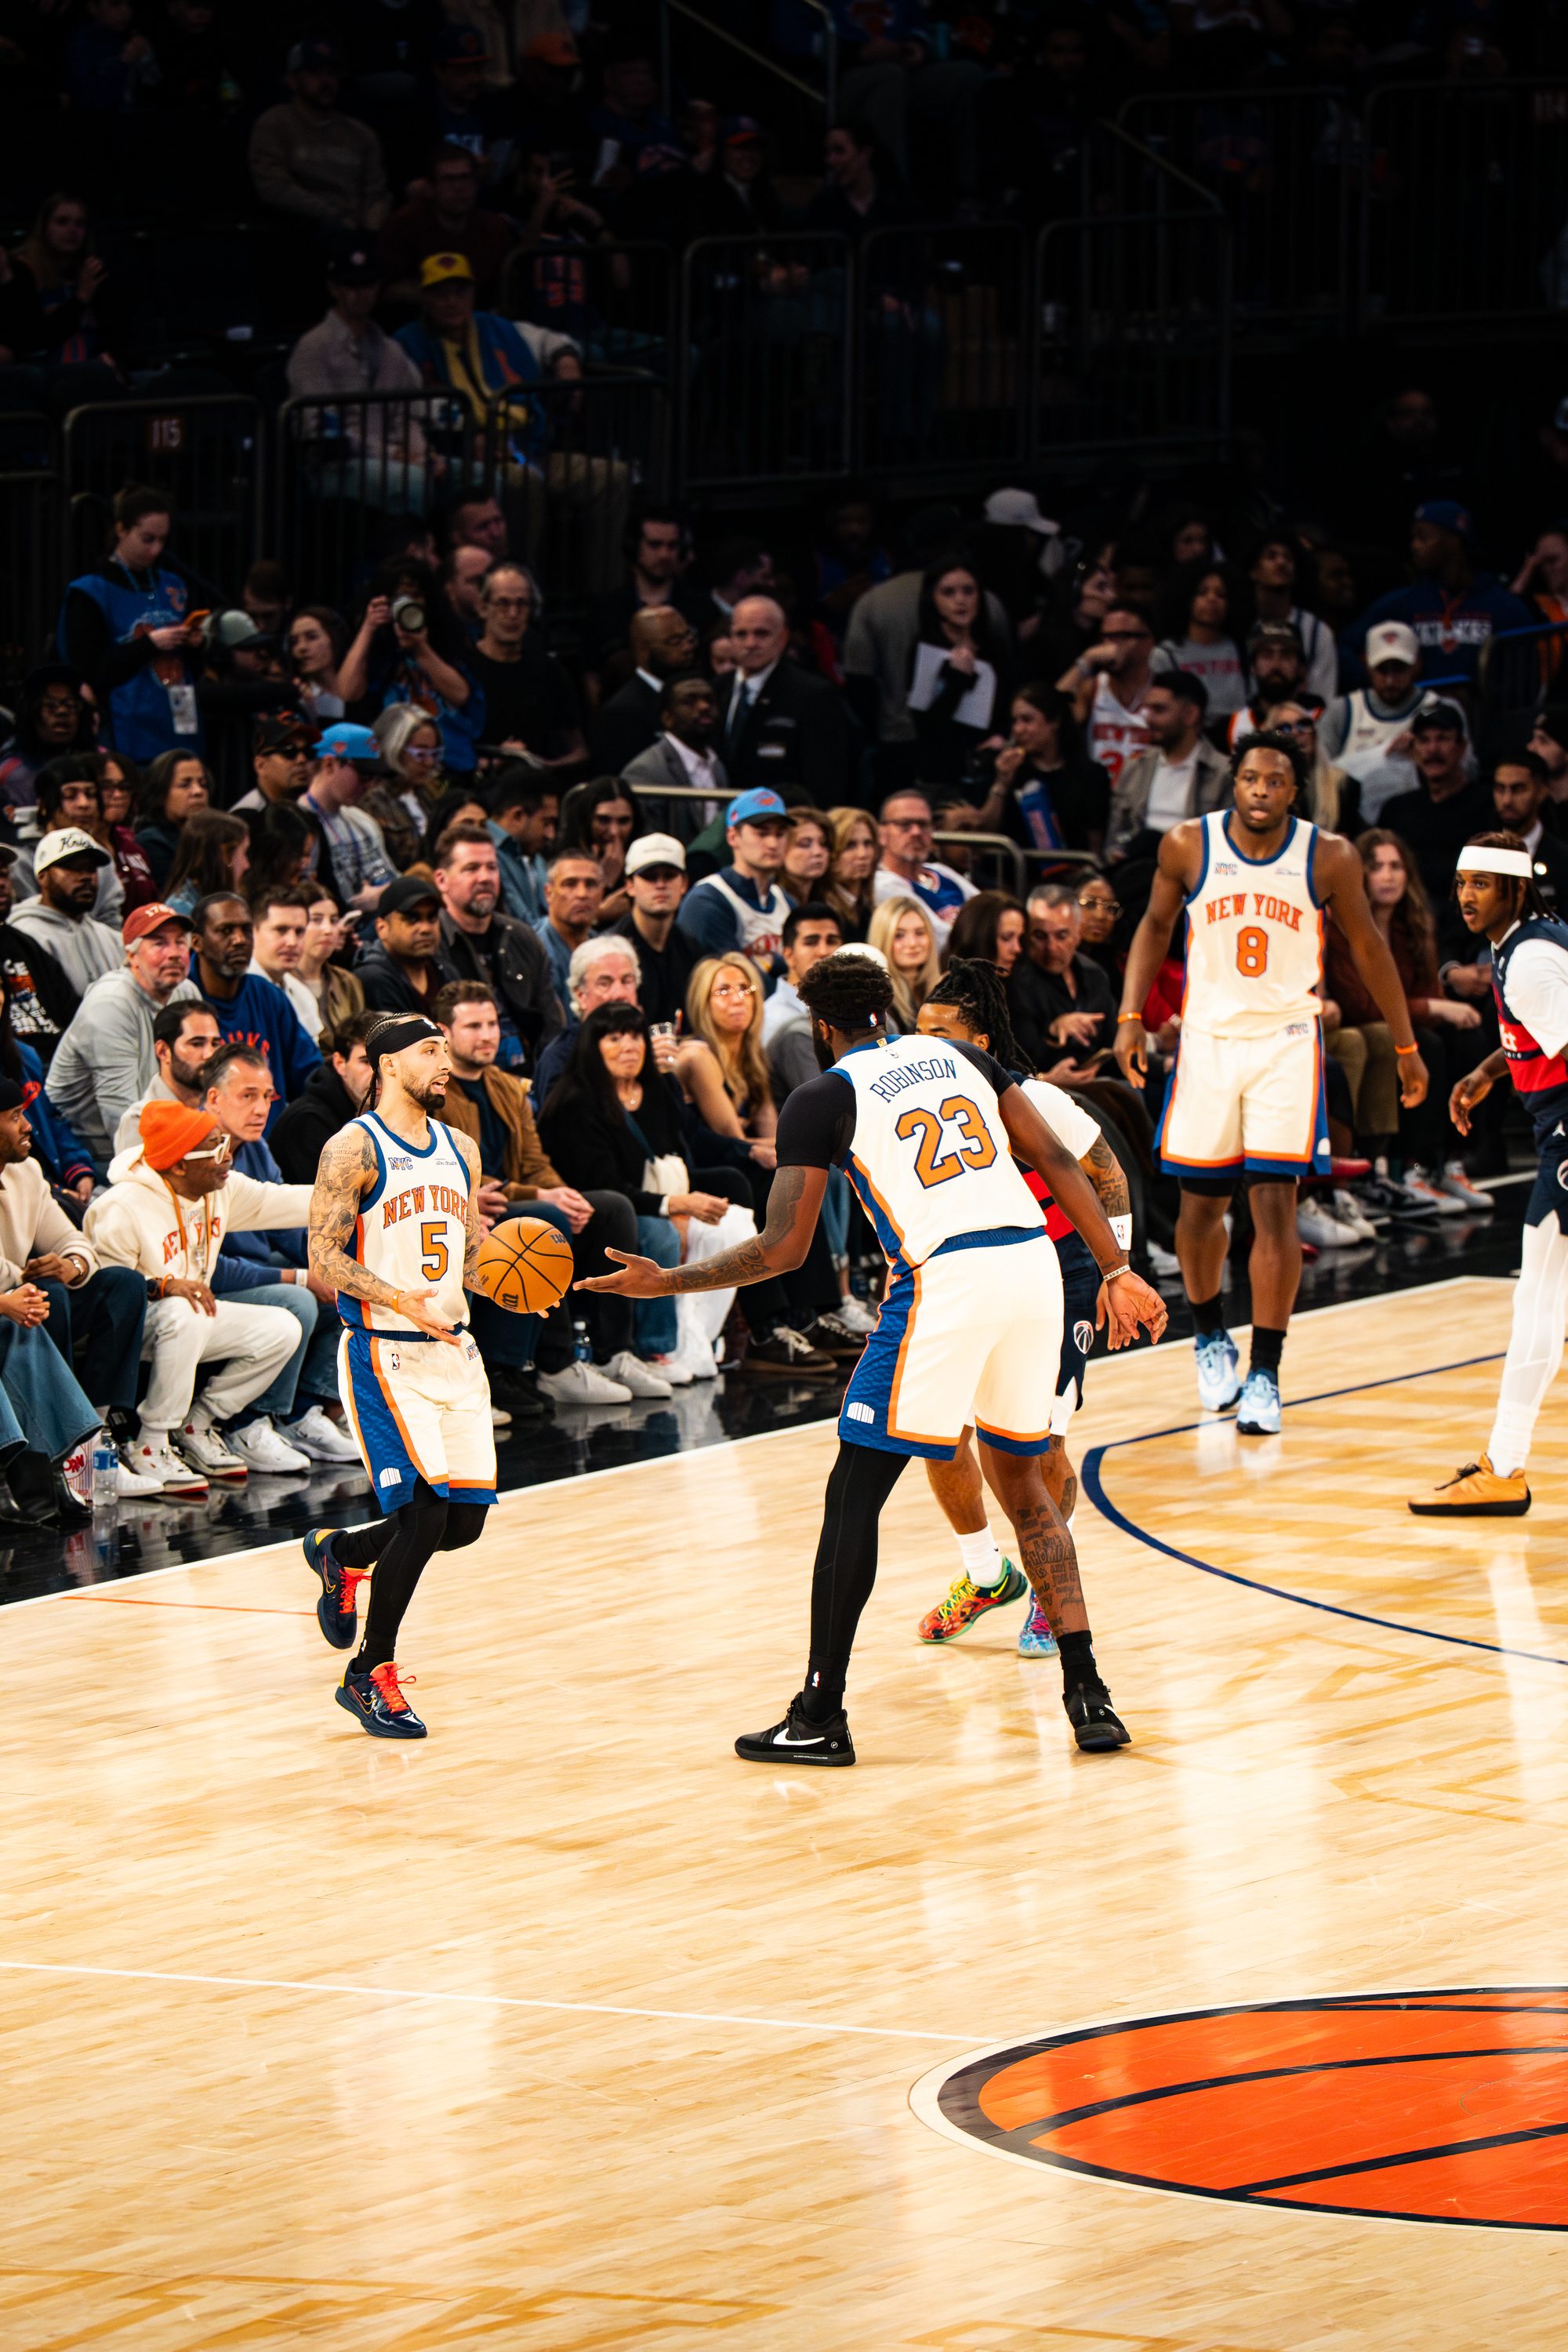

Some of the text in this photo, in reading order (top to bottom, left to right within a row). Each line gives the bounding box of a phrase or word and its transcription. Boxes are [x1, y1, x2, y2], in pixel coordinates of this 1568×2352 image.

[1205, 892, 1304, 933] NEW YORK
[1236, 926, 1269, 978] 8
[869, 1058, 957, 1103] ROBINSON
[895, 1094, 998, 1189] 23
[383, 1185, 468, 1230] NEW YORK
[420, 1221, 448, 1282] 5
